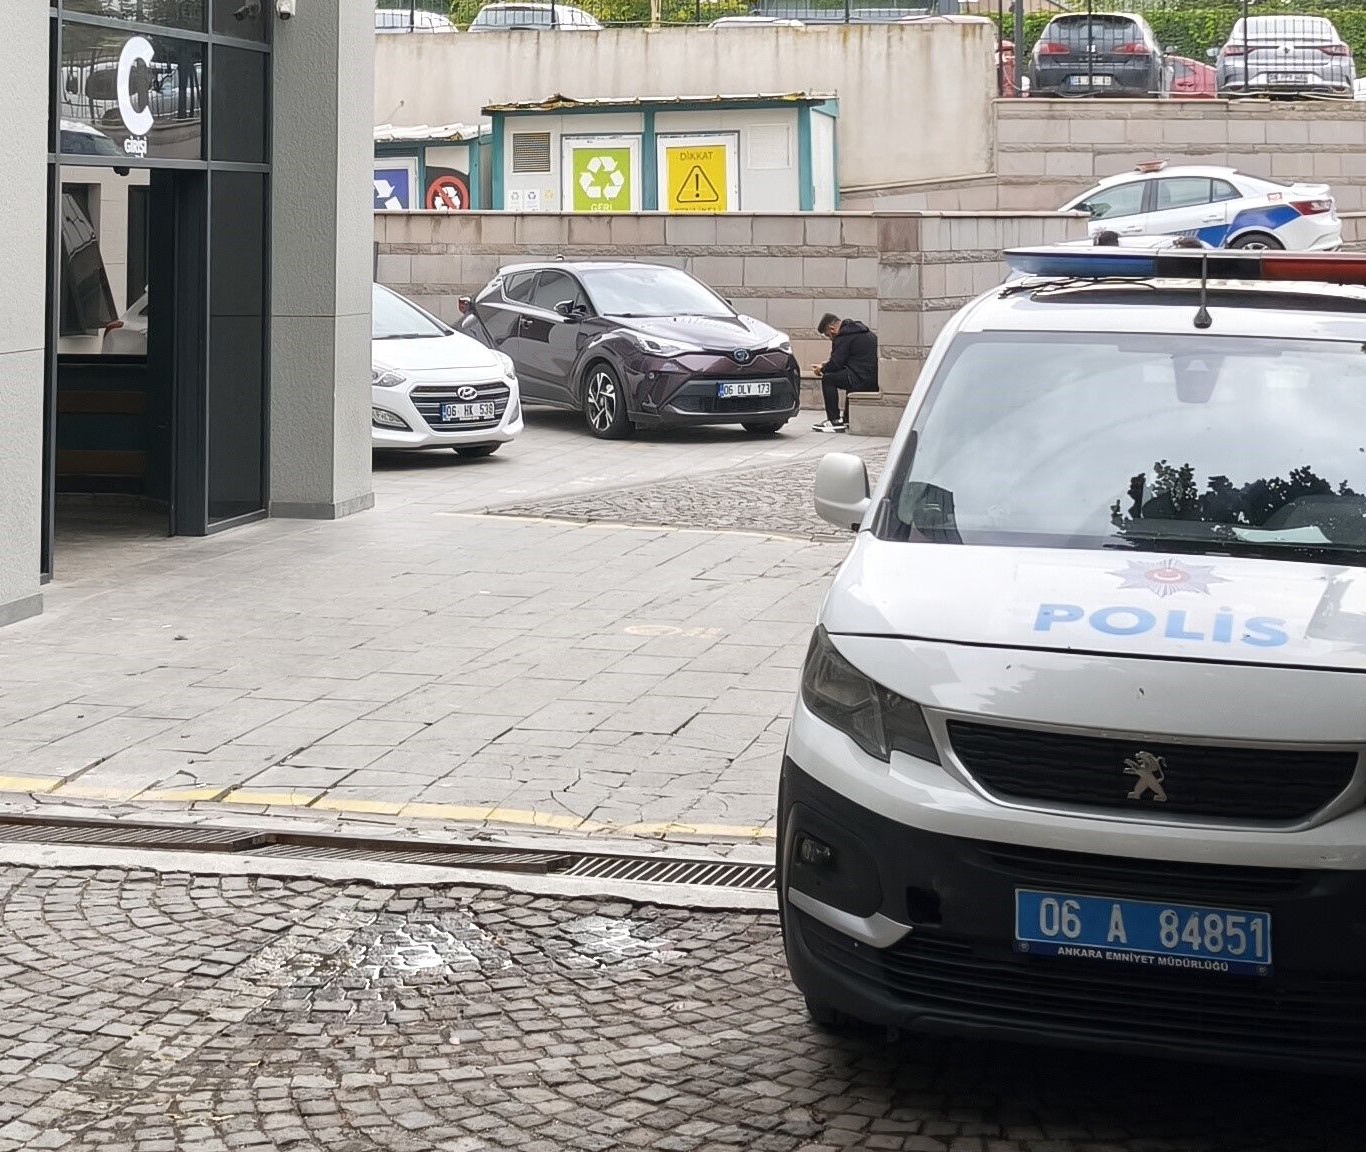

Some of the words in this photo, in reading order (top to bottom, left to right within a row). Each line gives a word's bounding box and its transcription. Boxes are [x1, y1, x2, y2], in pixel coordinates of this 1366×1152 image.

[679, 151, 714, 161] DİKKAT
[757, 383, 770, 394] 173
[446, 405, 456, 416] 06
[1033, 603, 1290, 647] POLİS
[1039, 898, 1081, 938] 06
[1107, 904, 1127, 944] A
[1159, 909, 1263, 957] 84851
[1057, 946, 1103, 960] ANKARA
[1105, 950, 1155, 965] EMNİYET
[1158, 956, 1229, 972] MÜDÜRLÜĞÜ
